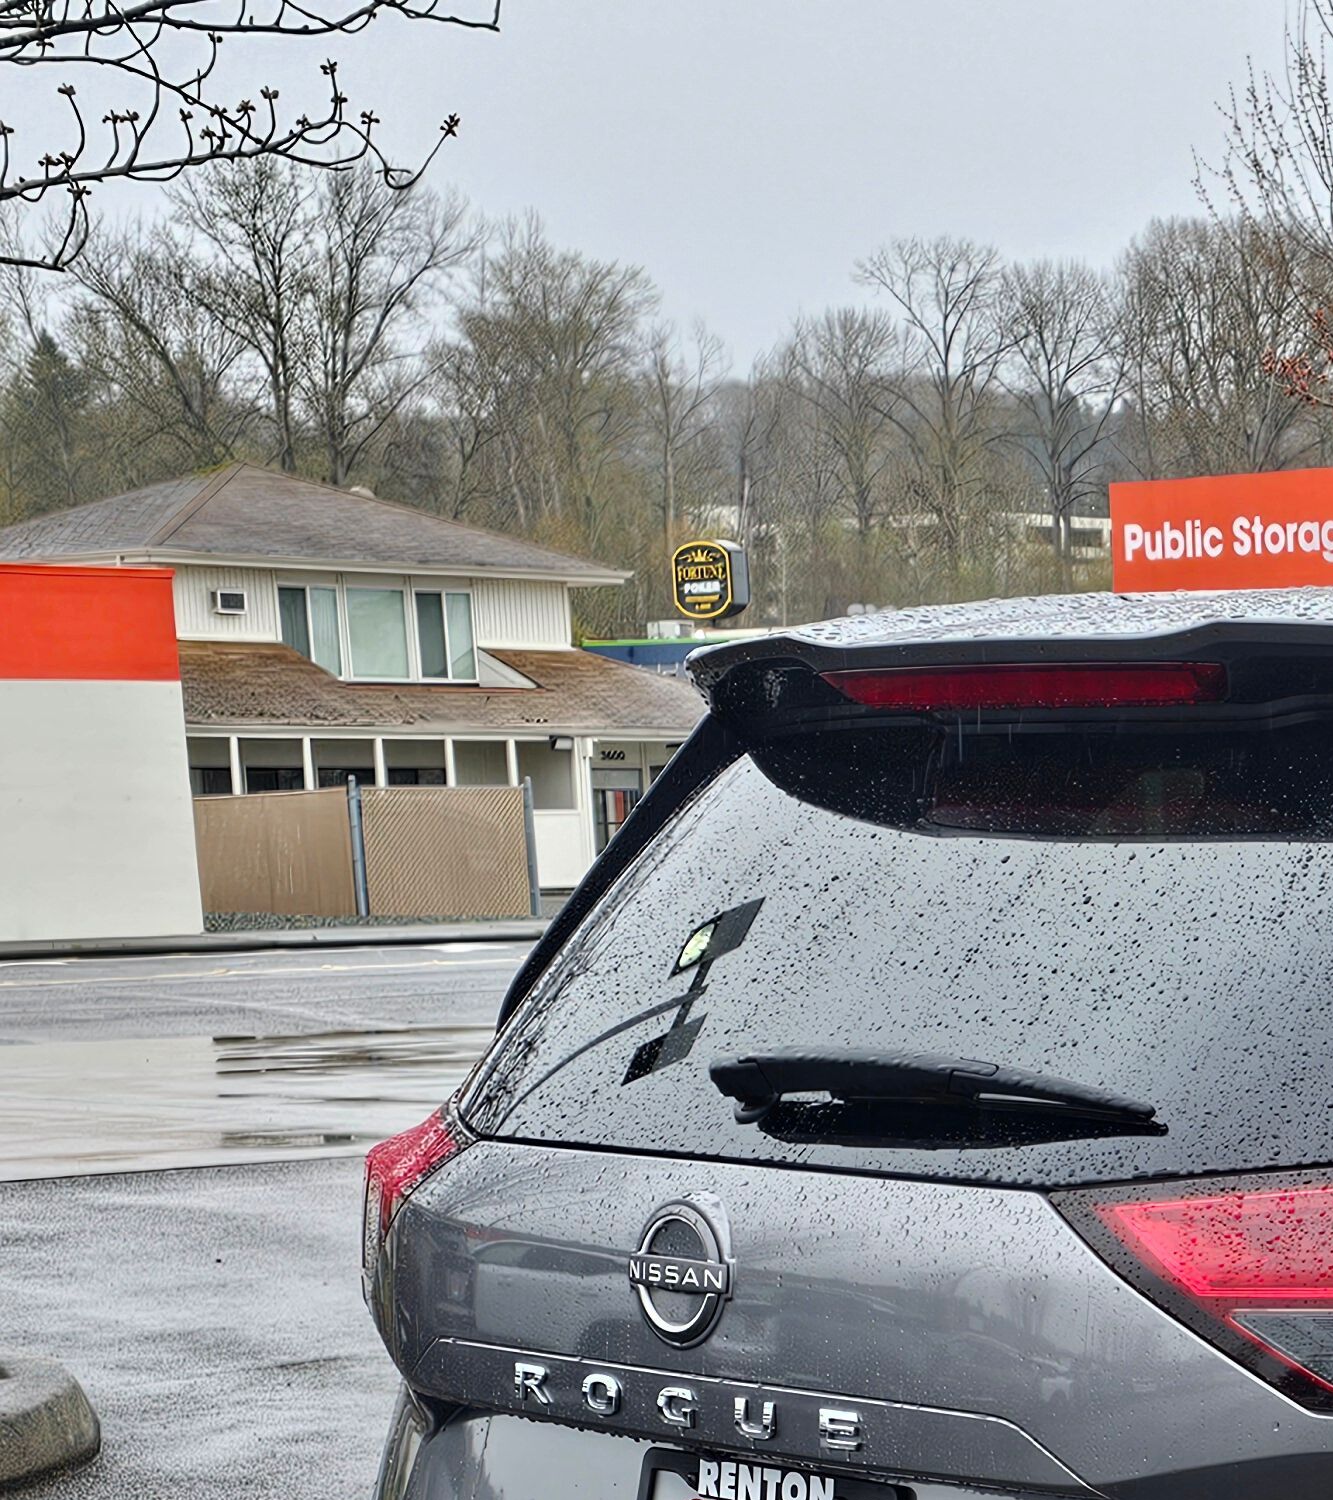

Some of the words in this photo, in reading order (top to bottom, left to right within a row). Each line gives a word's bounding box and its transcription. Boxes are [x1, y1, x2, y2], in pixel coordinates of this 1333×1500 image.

[1123, 519, 1224, 561] Public
[629, 1259, 723, 1289] NISSAN
[514, 1361, 864, 1451] ROGUE
